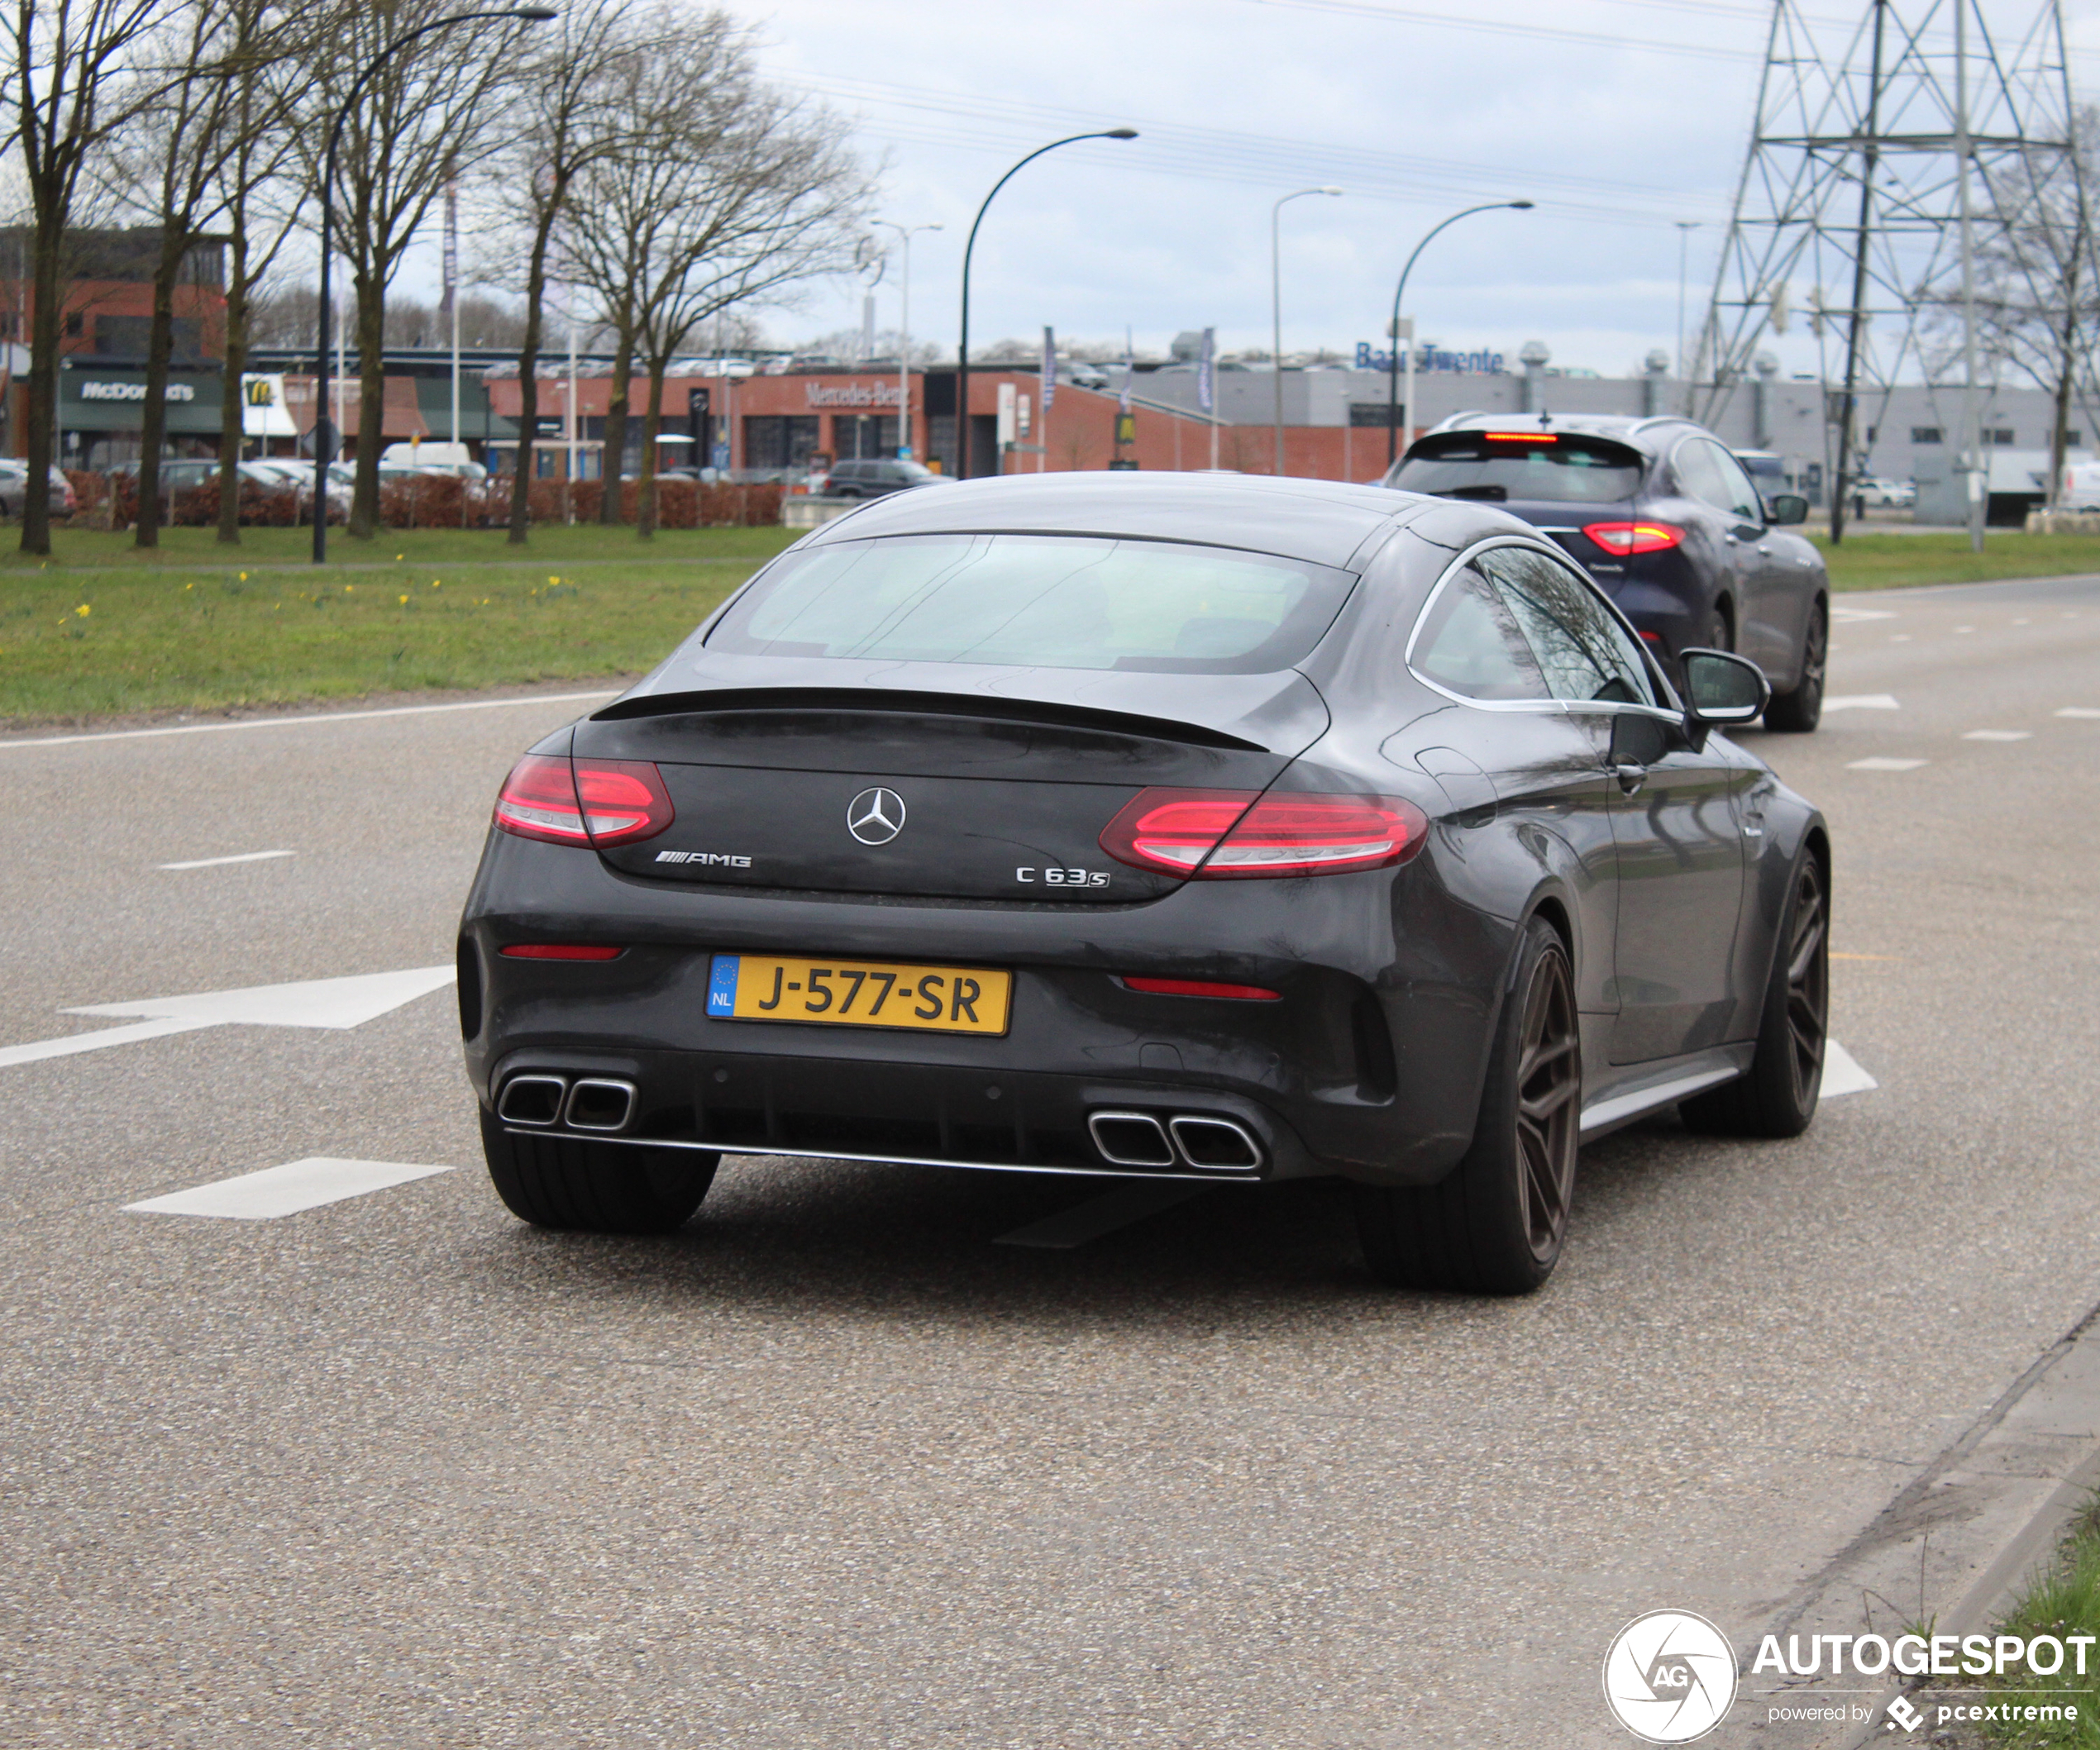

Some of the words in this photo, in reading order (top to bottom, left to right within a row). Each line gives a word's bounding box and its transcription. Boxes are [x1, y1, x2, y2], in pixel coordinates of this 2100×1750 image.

[1423, 344, 1503, 372] Twente
[805, 380, 910, 407] Mercedes-Ben
[685, 852, 752, 868] AMG
[1016, 866, 1035, 883] C
[713, 993, 731, 1006] NL
[758, 967, 981, 1023] J-577-SR
